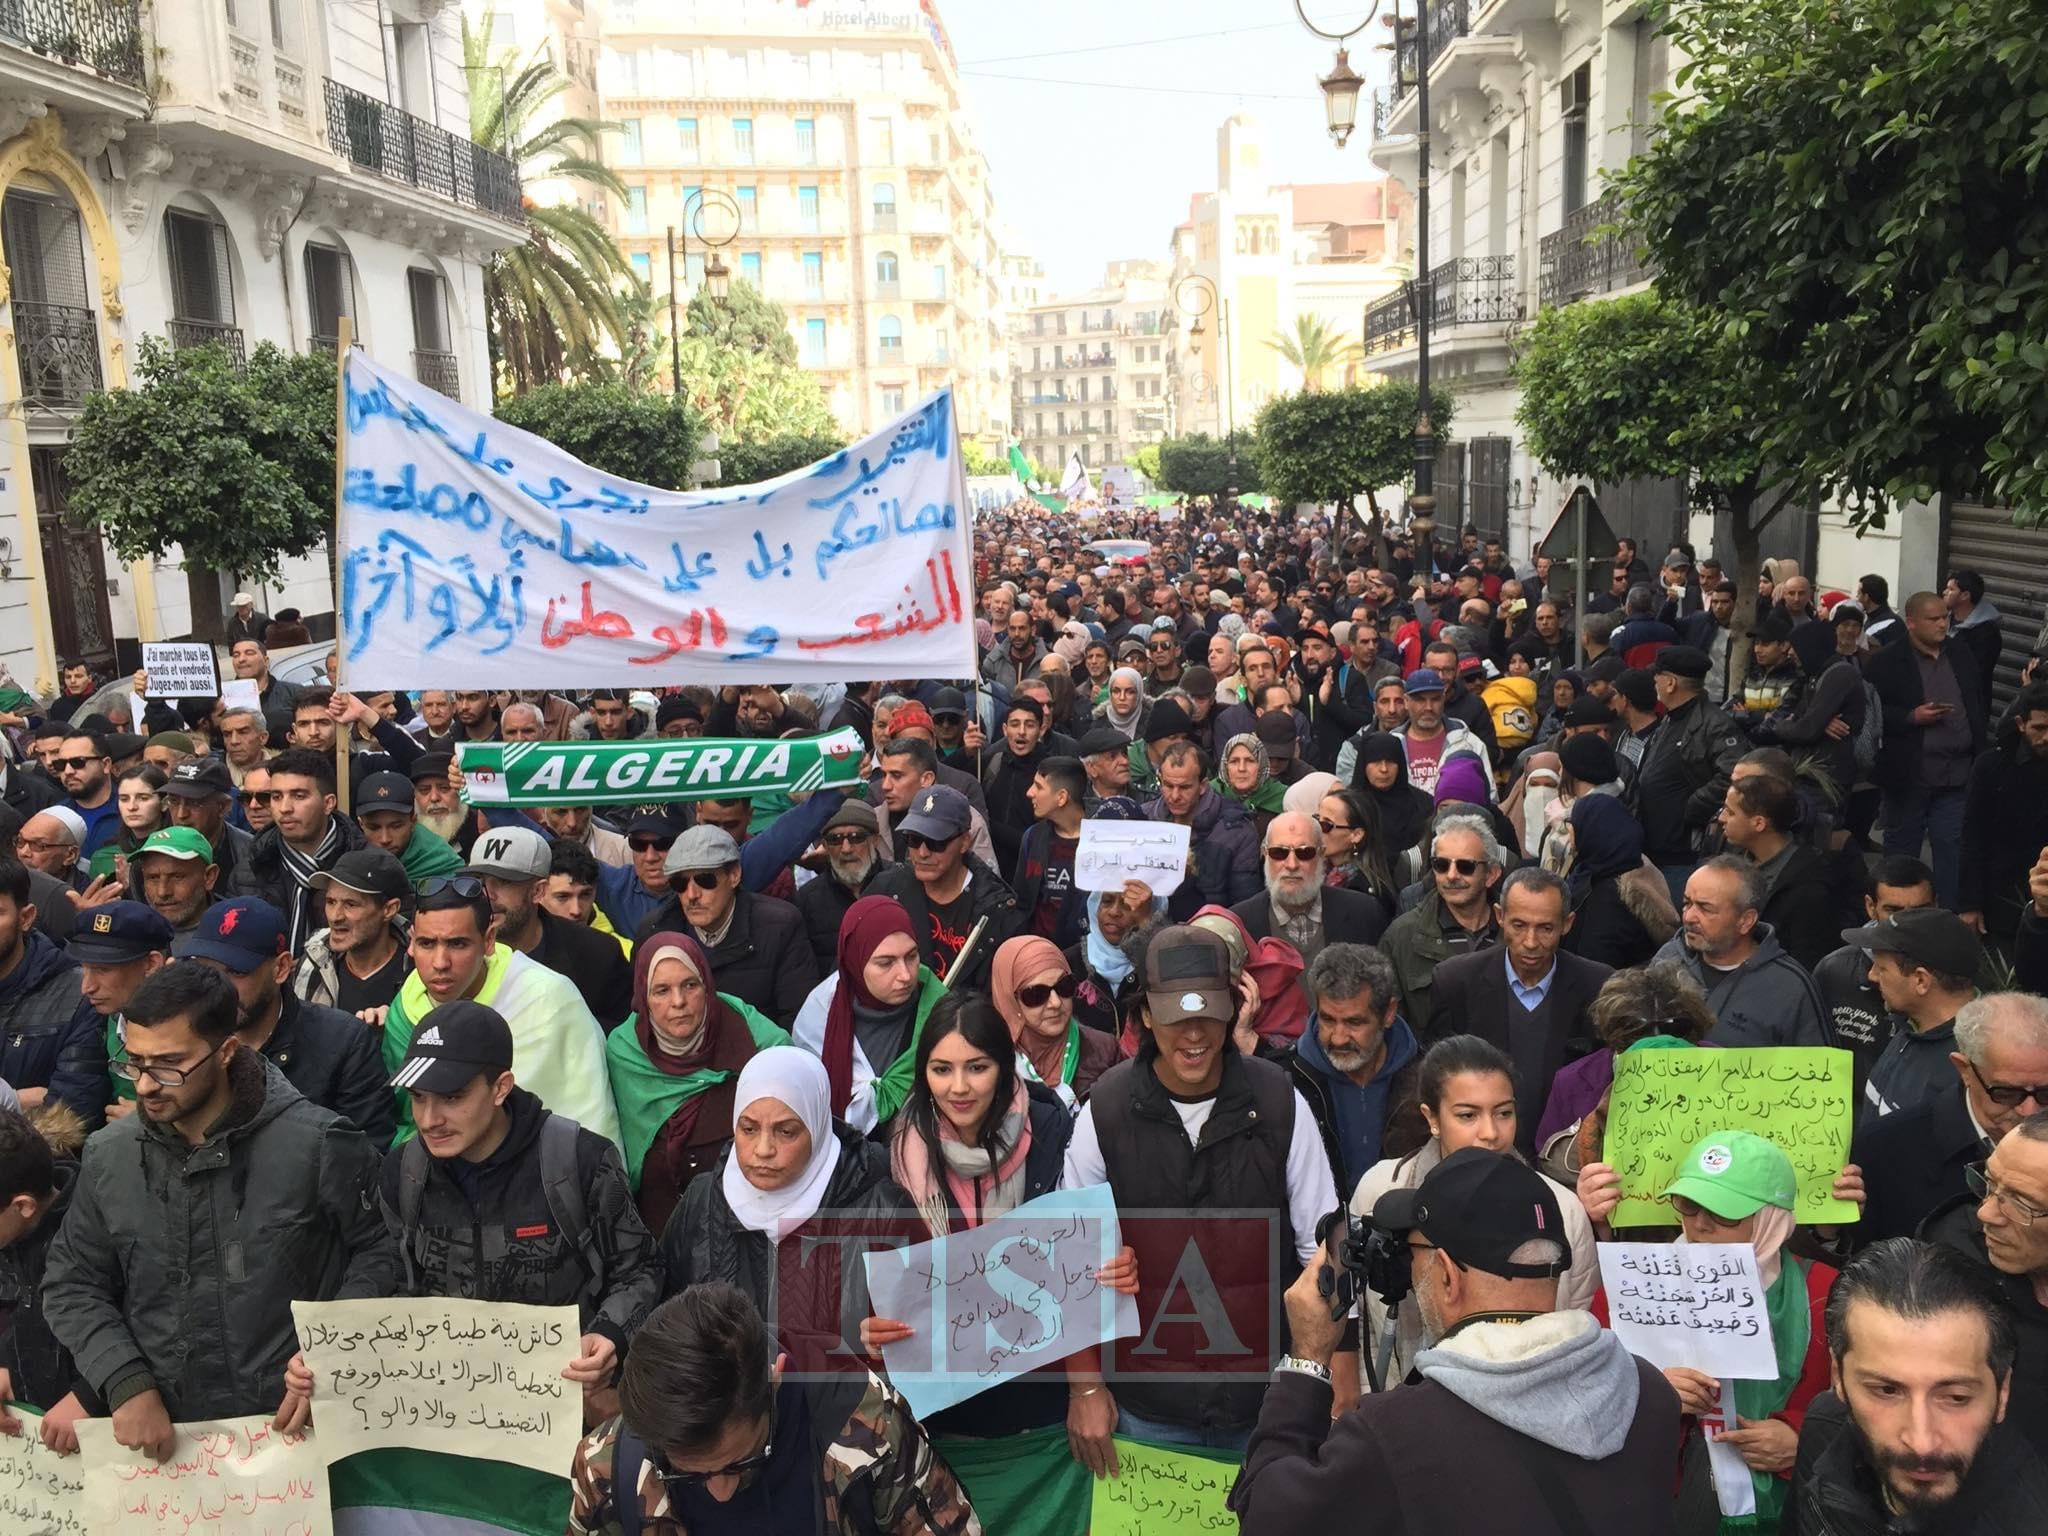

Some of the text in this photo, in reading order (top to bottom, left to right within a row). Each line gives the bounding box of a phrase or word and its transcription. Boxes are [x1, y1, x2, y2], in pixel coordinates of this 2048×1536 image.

[747, 529, 793, 579] بل
[816, 498, 956, 580] مصالحكم
[664, 541, 717, 592] على
[797, 549, 963, 650] الشعب
[541, 580, 728, 664] الوطن
[184, 648, 198, 661] tous
[199, 646, 210, 661] les
[725, 625, 780, 661] و
[147, 664, 212, 676] mardis et vendredis
[149, 677, 188, 694] Jugez-moi
[521, 744, 791, 791] ALGERIA
[483, 839, 512, 861] W
[417, 1037, 443, 1046] adidas
[918, 1213, 1086, 1291] الحرية مطلب لا
[1023, 1279, 1046, 1319] في
[303, 1322, 339, 1352] خلال
[442, 1313, 487, 1348] طيبة
[490, 1317, 520, 1348] نية
[519, 1321, 563, 1354] كاش
[952, 1292, 1014, 1351] التدافع
[977, 1312, 1064, 1377] السلمي
[451, 1360, 503, 1392] الحراك
[507, 1366, 563, 1399] تغطية
[1191, 1472, 1217, 1492] من
